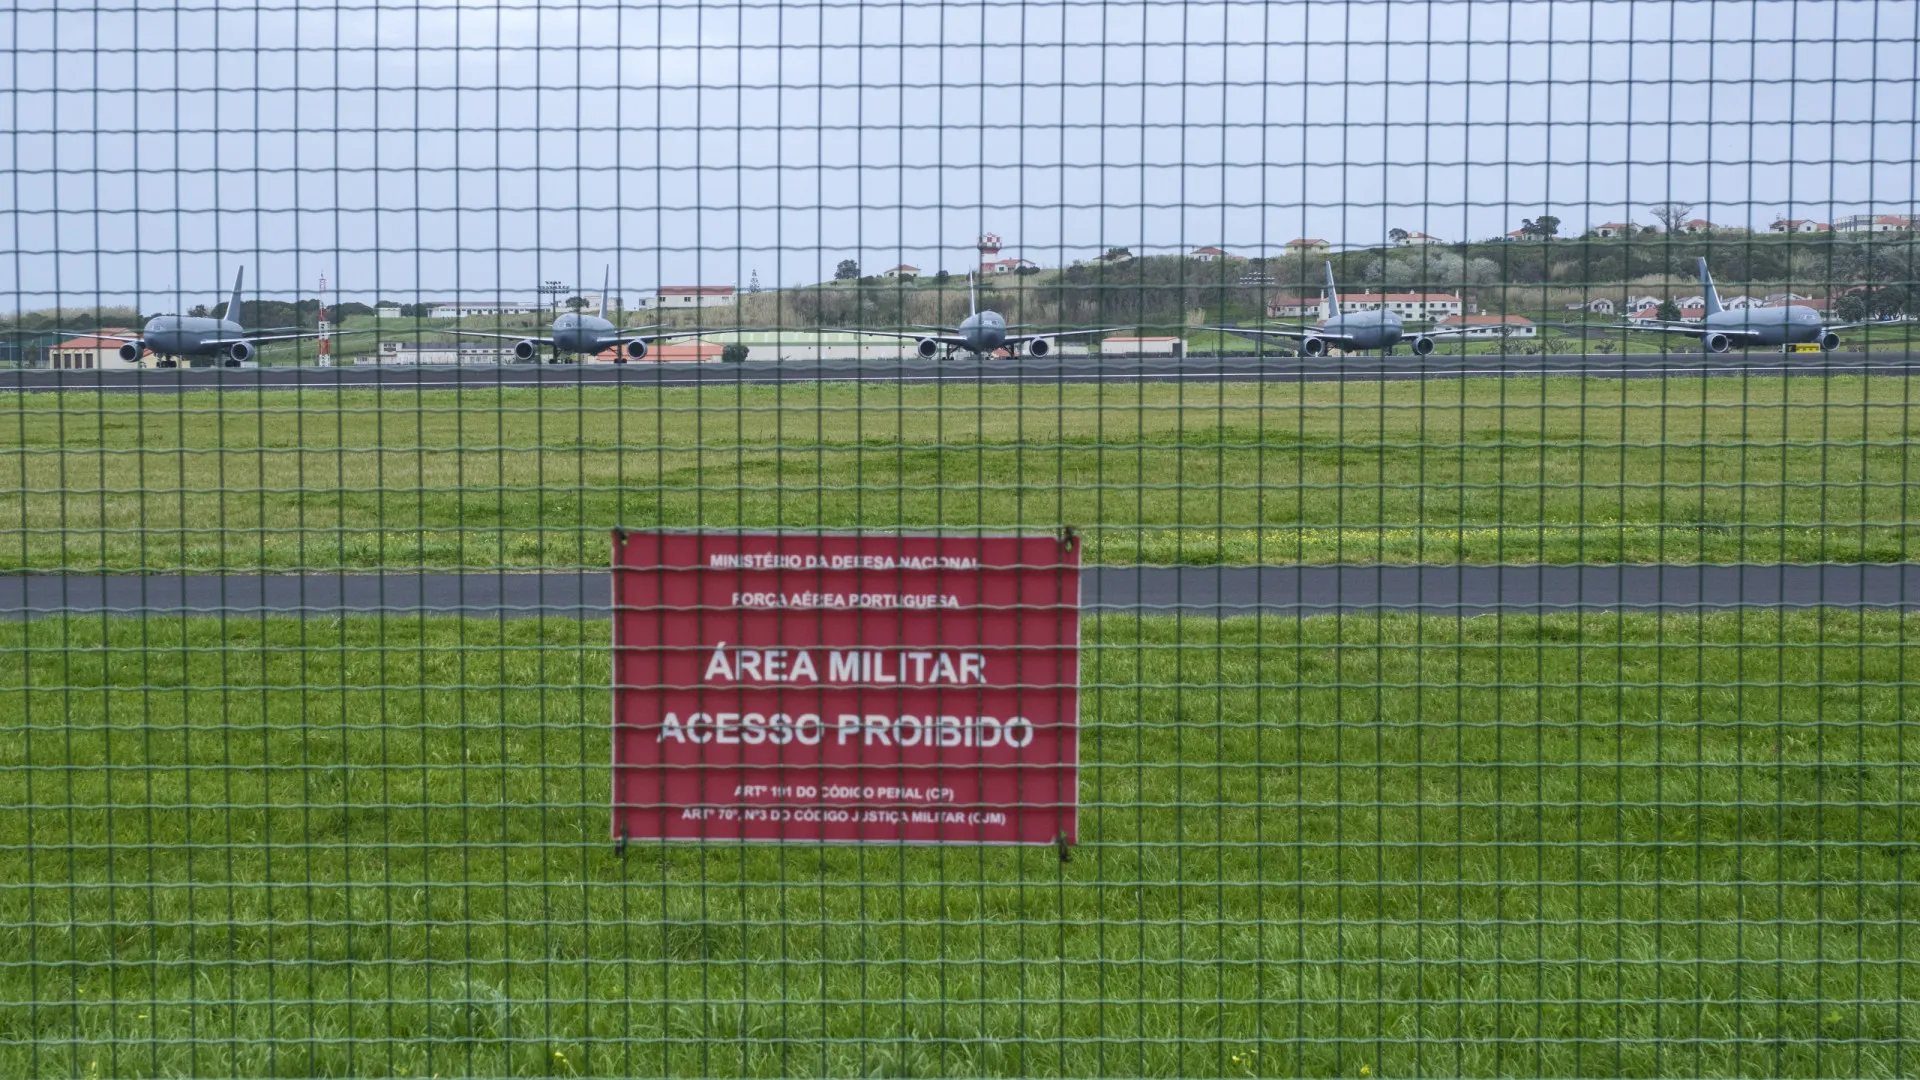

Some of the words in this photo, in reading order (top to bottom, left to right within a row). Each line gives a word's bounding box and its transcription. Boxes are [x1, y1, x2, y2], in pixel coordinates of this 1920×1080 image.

[805, 555, 829, 568] DA
[732, 592, 787, 607] FORÇA
[849, 593, 959, 609] PORTUGUESA
[705, 641, 818, 681] ÁREA
[829, 650, 987, 684] MILITAR
[656, 712, 825, 745] ACESSO
[837, 713, 1034, 748] PROIBIDO
[796, 786, 817, 798] DO
[821, 784, 875, 799] CÓDIGO
[877, 787, 923, 799] PENAL
[925, 787, 954, 801] (CP)
[770, 810, 791, 822] DO
[912, 811, 965, 824] MILITAR
